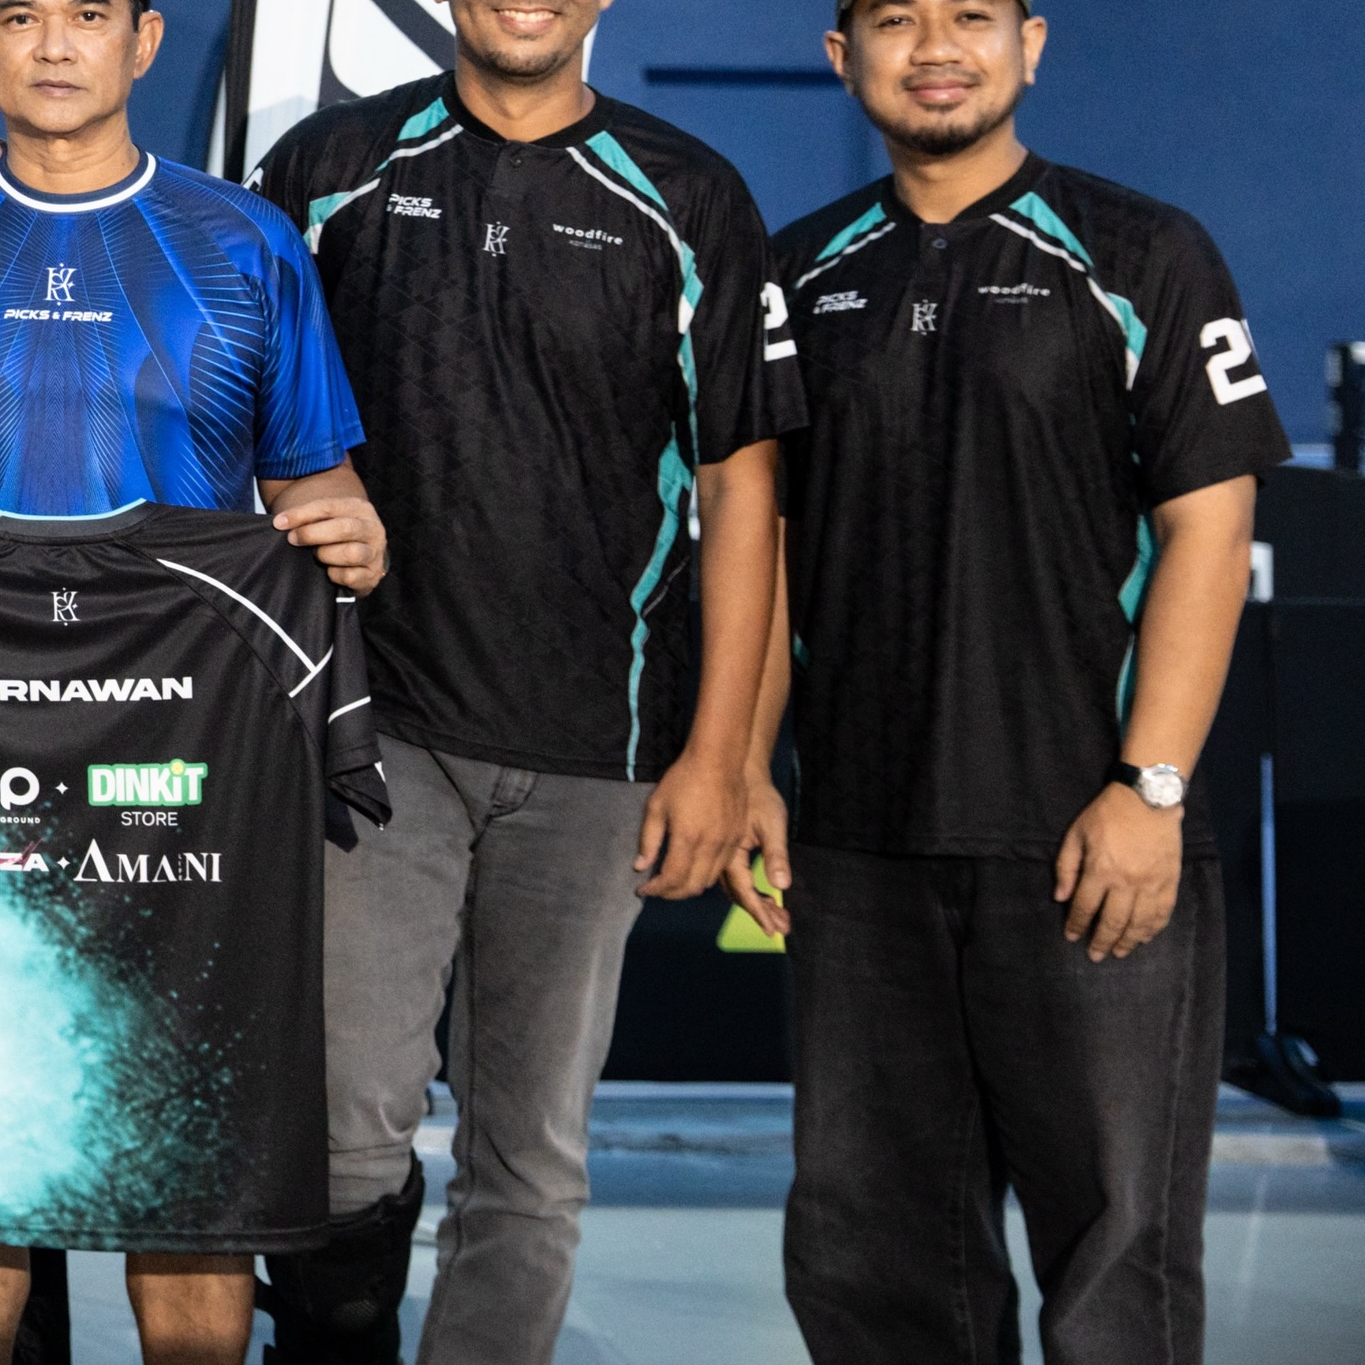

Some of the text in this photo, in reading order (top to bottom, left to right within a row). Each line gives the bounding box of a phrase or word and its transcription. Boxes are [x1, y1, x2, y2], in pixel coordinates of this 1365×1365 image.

[389, 193, 433, 207] PICKS
[394, 205, 442, 219] FRENZ
[552, 223, 623, 246] woodfire
[3, 309, 113, 322] PICKS & FRENZ
[1198, 317, 1268, 406] 2
[121, 811, 178, 826] STORE
[73, 838, 222, 883] AMANI
